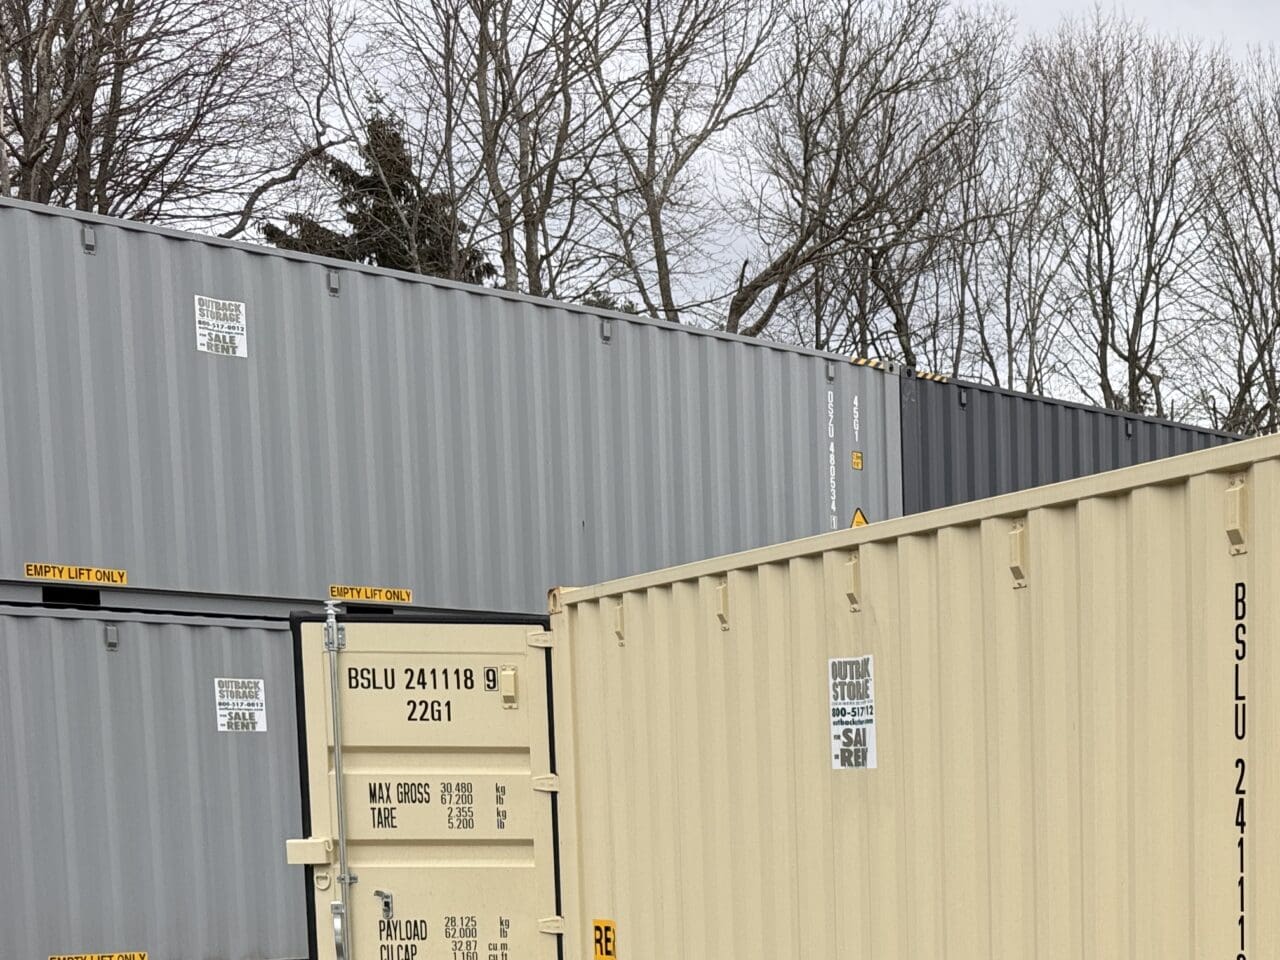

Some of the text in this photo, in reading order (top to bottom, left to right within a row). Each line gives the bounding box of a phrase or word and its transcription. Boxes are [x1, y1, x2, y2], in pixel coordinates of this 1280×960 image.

[208, 332, 236, 345] SALE
[206, 341, 238, 355] RENT
[26, 564, 125, 583] EMPTY LIFT ONLY
[330, 586, 411, 601] EMPTY LIFT ONLY
[1234, 583, 1247, 740] BSLU
[348, 667, 497, 690] BSLU 241118 9
[227, 712, 255, 720] SALE
[406, 700, 452, 722] 22G1
[227, 721, 258, 730] RENT
[368, 782, 392, 804] MAX
[397, 782, 430, 804] GROSS
[495, 782, 506, 796] kg
[495, 794, 504, 805] lb
[370, 807, 398, 829] TARE
[496, 807, 507, 820] kg
[497, 818, 505, 829] lb
[379, 919, 428, 941] PAYLOAD
[499, 916, 510, 929] kg
[499, 928, 508, 939] lb
